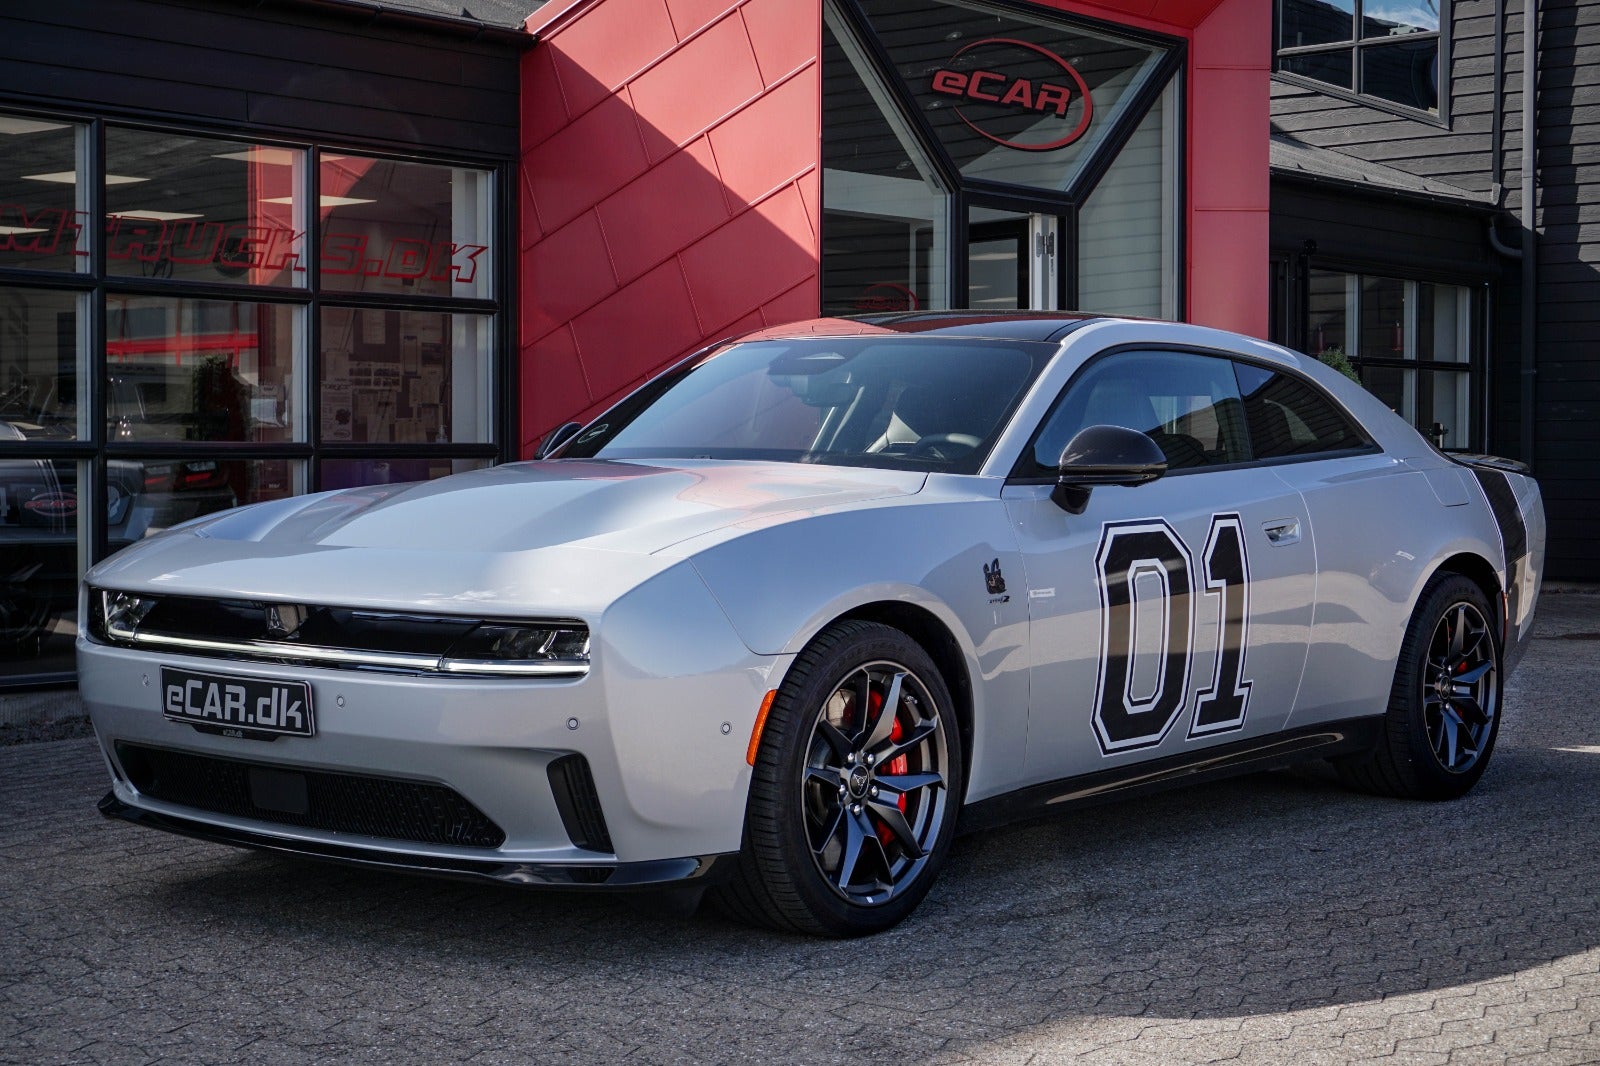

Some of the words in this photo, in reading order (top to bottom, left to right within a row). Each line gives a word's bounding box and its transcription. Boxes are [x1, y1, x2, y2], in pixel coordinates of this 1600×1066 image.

[931, 69, 1071, 115] eCAR
[1091, 512, 1253, 757] 01
[166, 679, 302, 729] eCAR.dk
